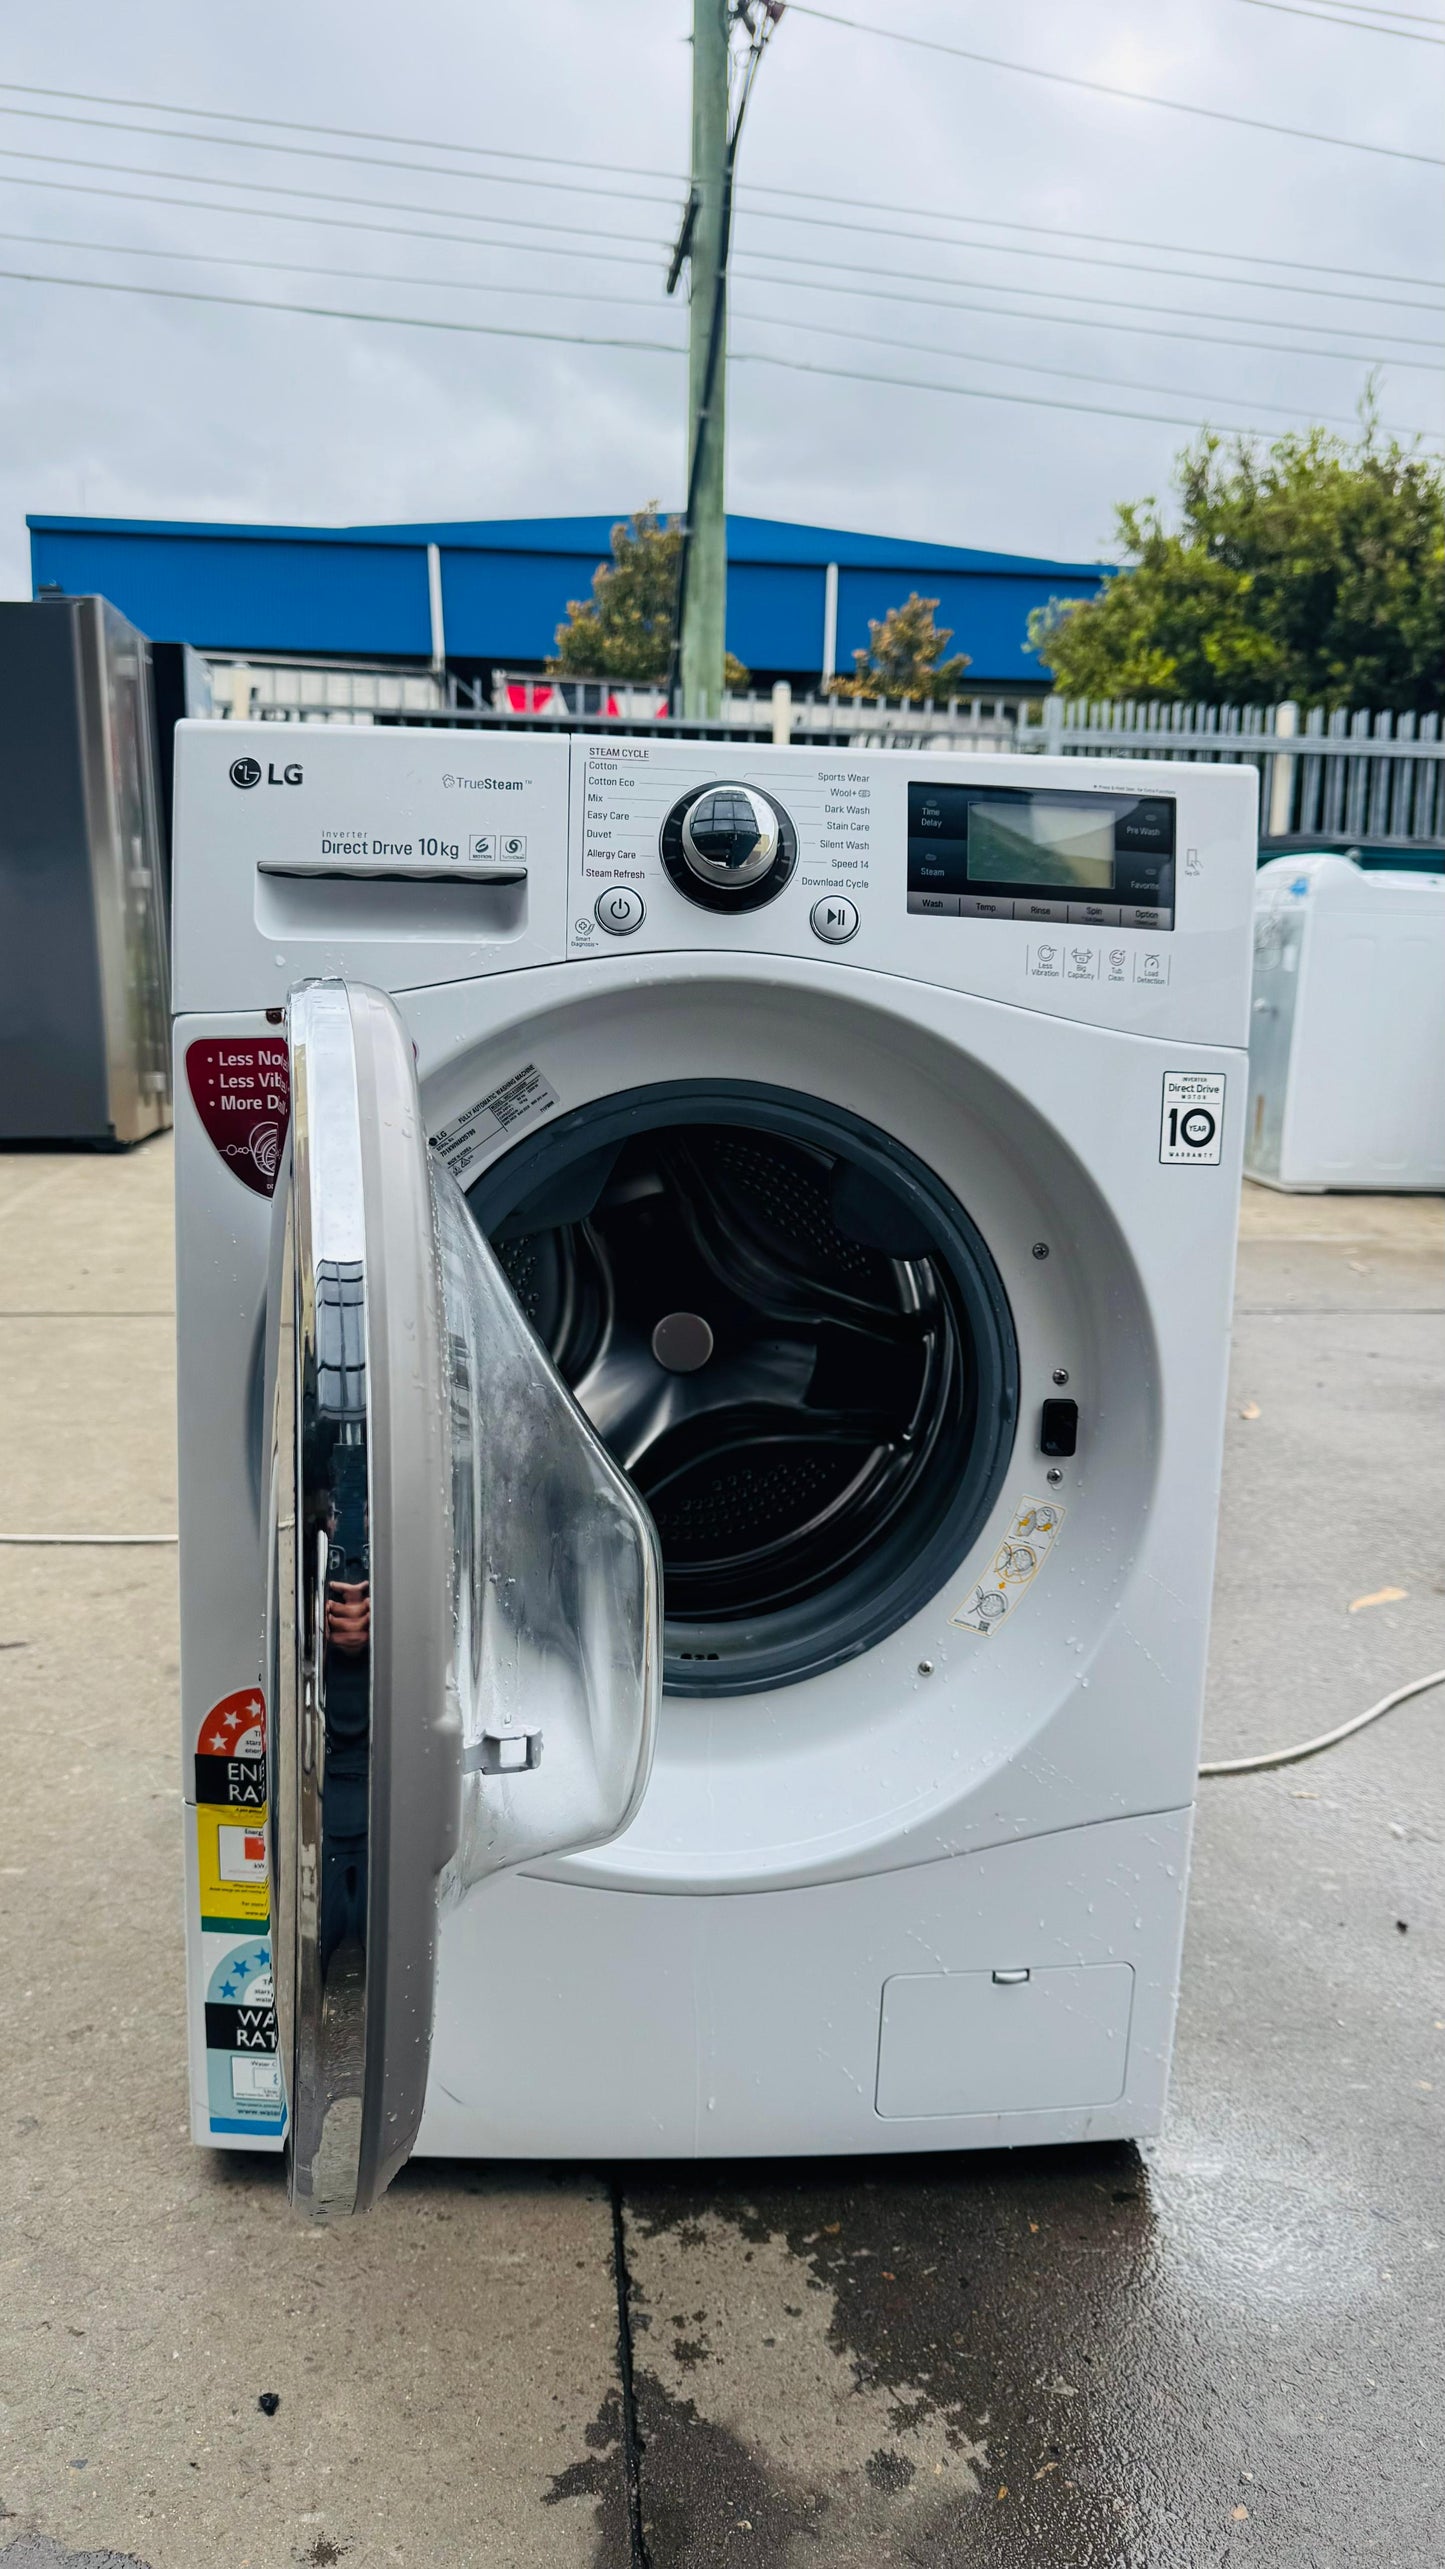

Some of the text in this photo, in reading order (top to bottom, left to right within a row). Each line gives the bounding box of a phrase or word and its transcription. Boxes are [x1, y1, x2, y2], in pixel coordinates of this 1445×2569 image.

[589, 747, 650, 758] STEAM CYCLE
[589, 761, 618, 770] Cotton
[267, 763, 303, 785] LG
[818, 772, 870, 783] Sports Wear
[589, 776, 635, 787] Cotton Eco
[588, 793, 603, 802] Mix
[824, 804, 870, 815] Dark Wash
[922, 807, 940, 816] Time
[587, 810, 630, 821] Easy Care
[826, 821, 870, 831] Stain Care
[921, 818, 943, 829] Delay
[322, 830, 369, 838] Inverter
[586, 829, 612, 838] Duvet
[1126, 826, 1160, 836] Pre Wash
[322, 839, 369, 855] Direct
[373, 840, 412, 855] Drive
[820, 839, 869, 850] Silent Wash
[587, 849, 636, 860] Allergy Care
[831, 859, 869, 869] Speed 14
[586, 868, 645, 879] Steam Refresh
[920, 867, 945, 877] Steam
[801, 877, 869, 889] Download Cycle
[922, 899, 944, 909] Wash
[976, 903, 997, 913] Temp
[1030, 906, 1051, 916] Rinse
[1086, 906, 1103, 916] Spin
[1135, 910, 1159, 919] Option
[1031, 969, 1060, 977] Vibration
[1067, 971, 1095, 980] Capacity
[219, 1050, 281, 1066] Less No
[220, 1073, 254, 1088] Less
[1168, 1083, 1219, 1093] Direct Drive
[458, 1112, 473, 1124] FULLY
[473, 1093, 497, 1114] AUTOMATIC
[515, 1064, 536, 1082] MACHINE
[221, 1095, 262, 1110] More
[1168, 1108, 1216, 1148] 10
[238, 2009, 274, 2028] WA
[236, 2029, 276, 2048] RAT
